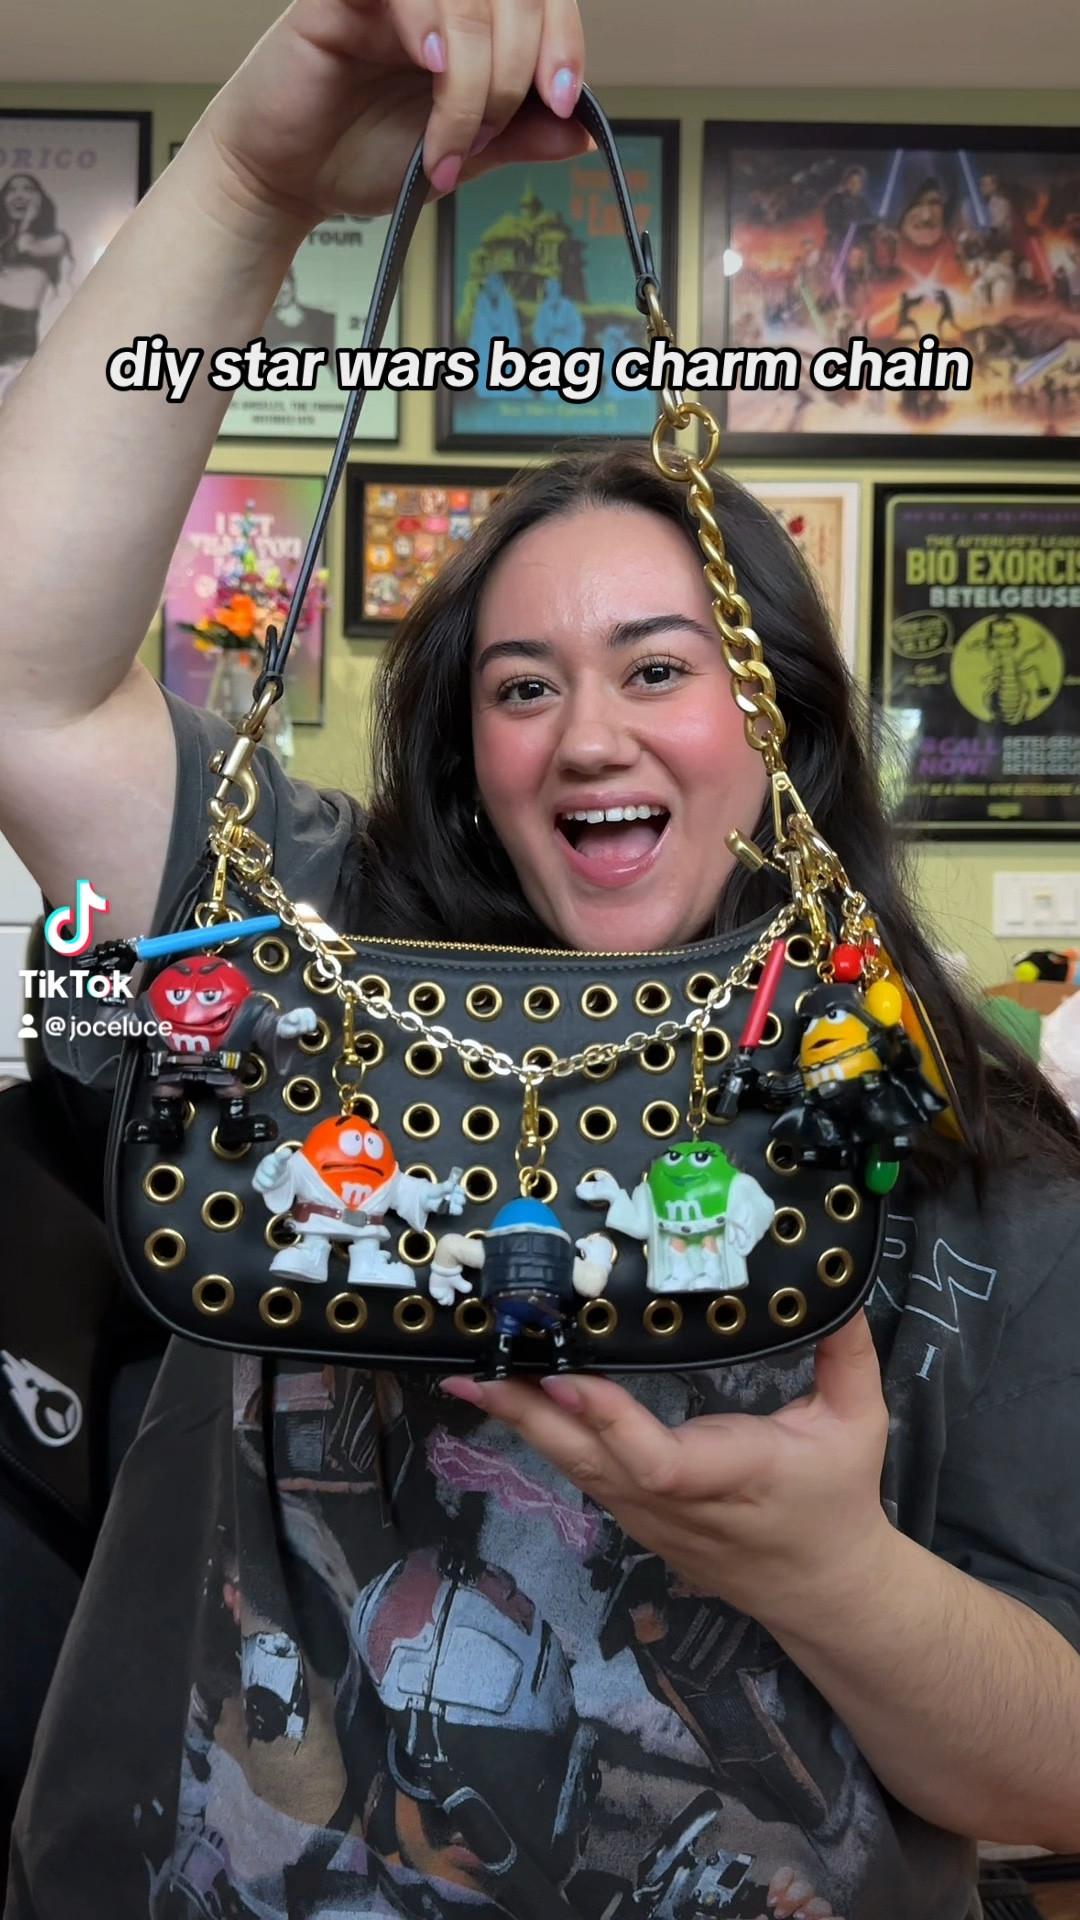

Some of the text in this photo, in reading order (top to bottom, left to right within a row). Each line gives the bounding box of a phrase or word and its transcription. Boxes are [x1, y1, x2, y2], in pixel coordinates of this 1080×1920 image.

[906, 549, 958, 585] BIO
[929, 586, 1080, 608] BETELGEUSE
[171, 1032, 210, 1052] m
[664, 1199, 704, 1222] m
